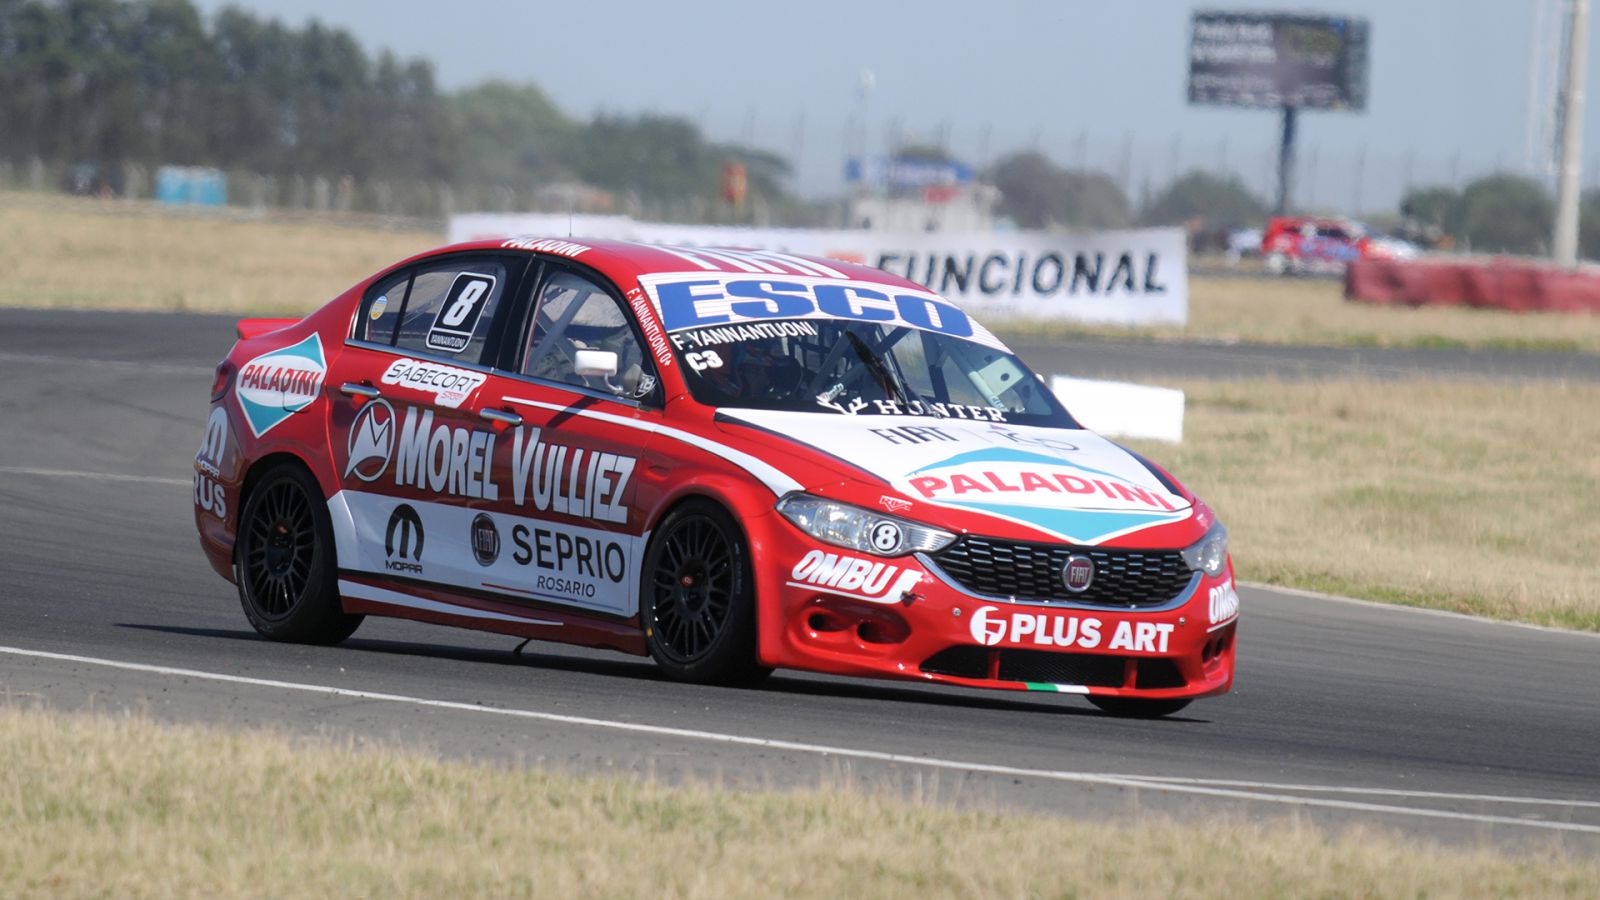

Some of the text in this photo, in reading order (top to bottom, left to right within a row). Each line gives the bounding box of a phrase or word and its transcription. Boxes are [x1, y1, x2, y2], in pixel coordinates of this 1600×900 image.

[501, 239, 591, 257] PALADINI
[442, 280, 488, 326] 8
[656, 280, 973, 337] ESCO
[685, 350, 723, 371] C3
[241, 364, 321, 396] PALADINI
[387, 363, 480, 393] SABECORT
[873, 400, 1007, 422] HUNTER
[868, 425, 960, 444] FIAT
[395, 406, 637, 524] MOREL VULLIEZ
[909, 471, 1176, 512] PALADINI
[875, 525, 897, 550] 8
[385, 560, 424, 574] MOPAR
[512, 524, 626, 583] SEPRIO
[537, 575, 595, 598] ROSARIO
[1070, 564, 1090, 584] FIAT
[1010, 613, 1174, 653] PLUS ART
